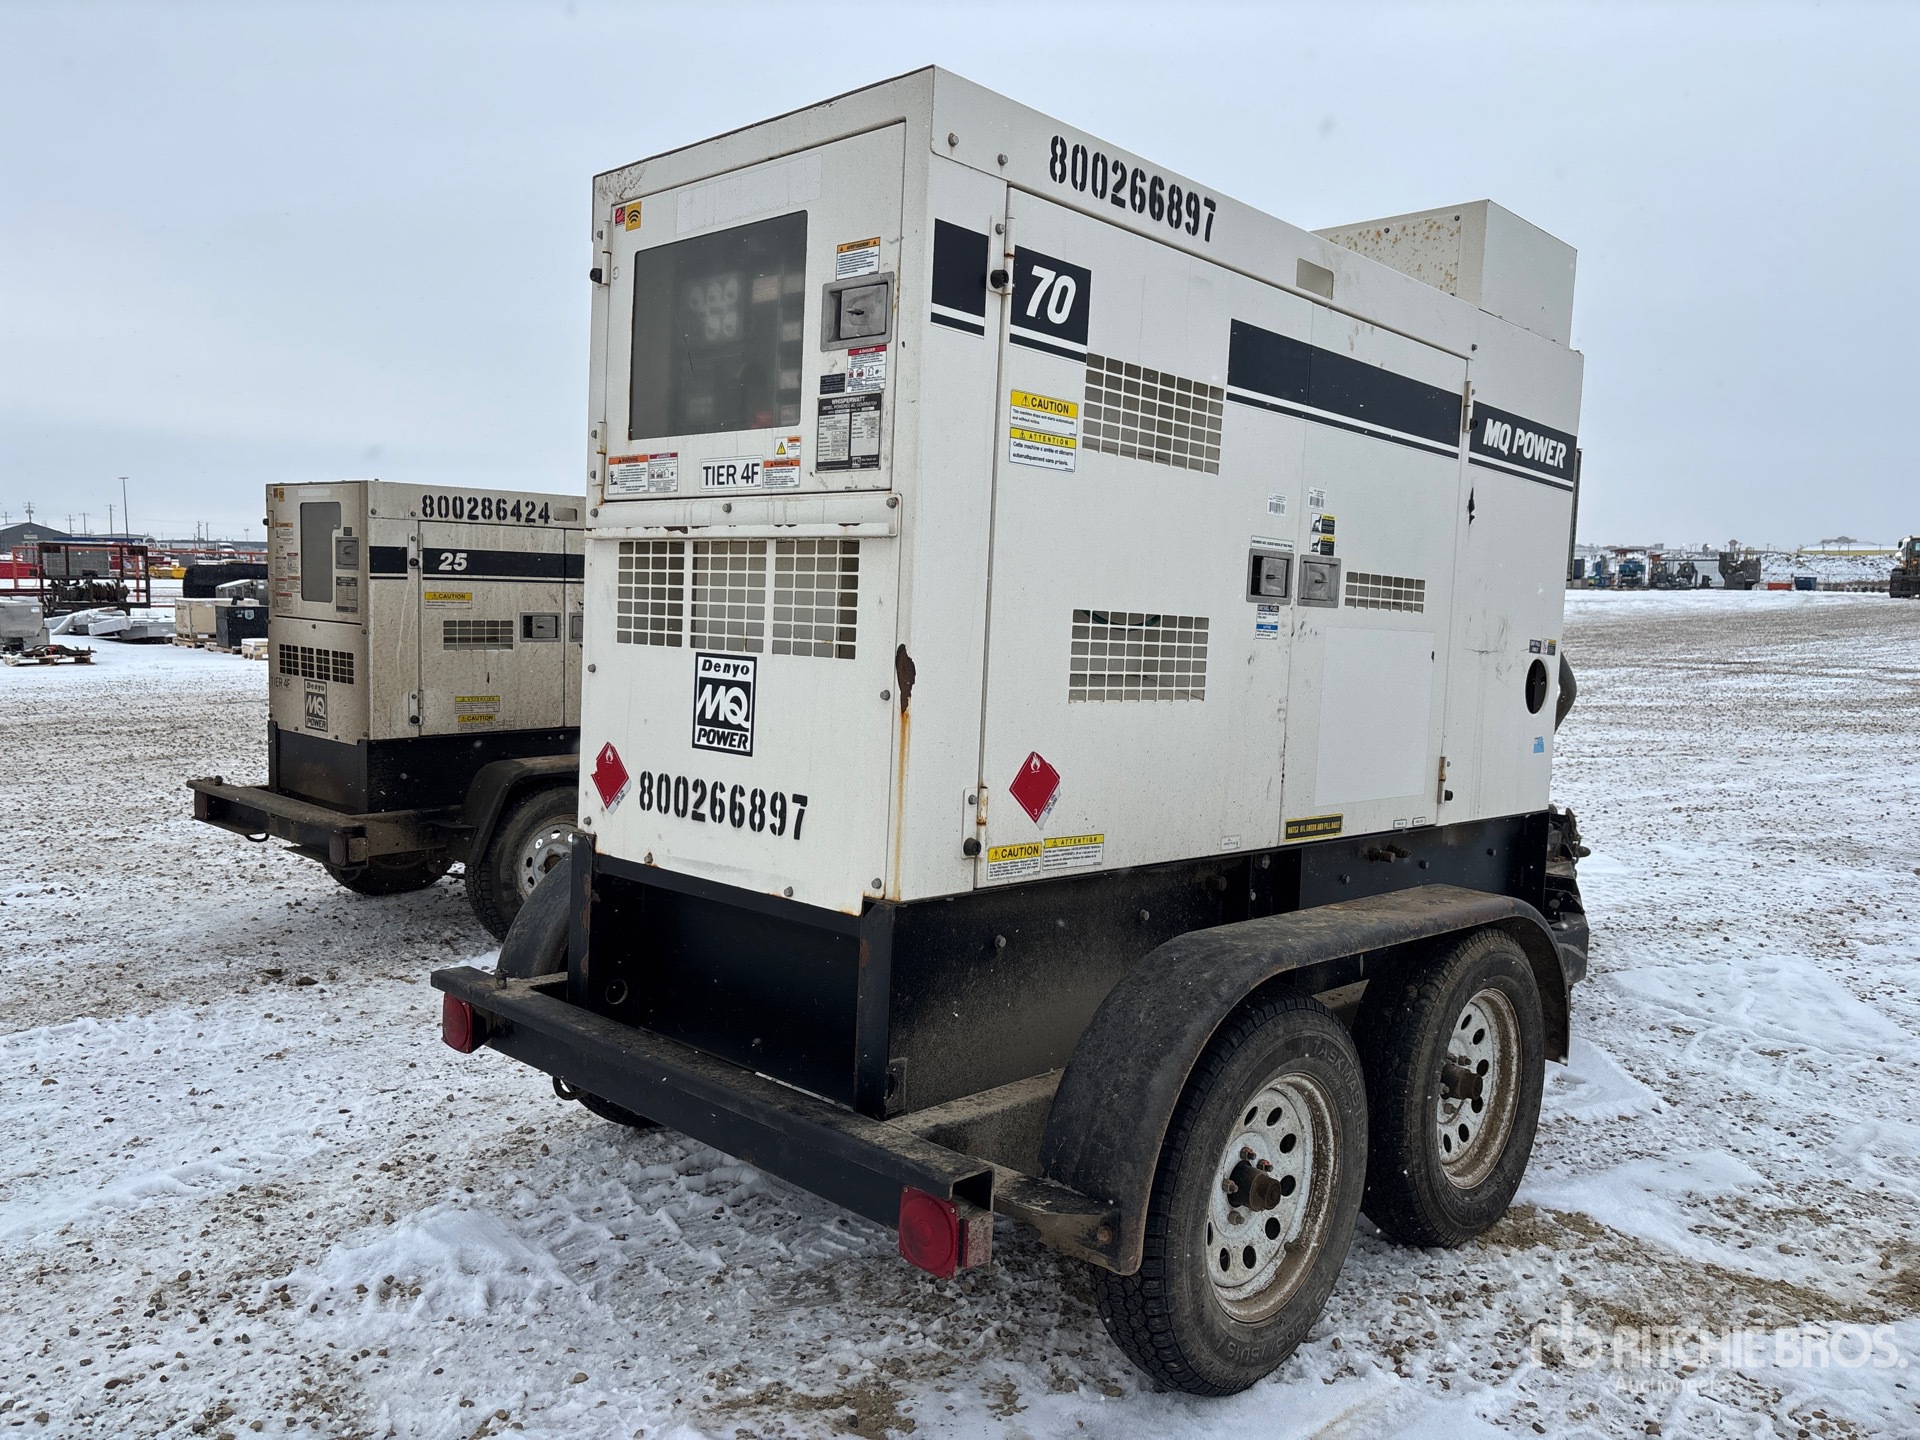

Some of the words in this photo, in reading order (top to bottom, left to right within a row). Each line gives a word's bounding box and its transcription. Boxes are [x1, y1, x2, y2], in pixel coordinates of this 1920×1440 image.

[1049, 135, 1216, 242] 800266897
[1026, 265, 1076, 324] 70
[1031, 397, 1069, 414] CAUTION
[1024, 443, 1039, 451] machine
[1029, 434, 1069, 445] ATTENTION
[1483, 418, 1512, 456] MQ
[1512, 428, 1566, 469] POWER
[703, 464, 737, 486] TIER
[740, 463, 760, 484] 4F
[422, 494, 550, 524] 800286424
[438, 552, 468, 571] 25
[702, 659, 750, 678] Denyo
[270, 676, 282, 688] TIER
[307, 682, 325, 692] Denyo
[306, 695, 326, 719] MQ
[697, 684, 750, 729] MQ
[307, 717, 326, 728] POWER
[696, 727, 749, 750] POWER
[639, 770, 808, 840] 800266897
[1061, 836, 1098, 845] ATTENTION
[1001, 845, 1039, 859] CAUTION
[1314, 1040, 1366, 1151] TASKMASTER
